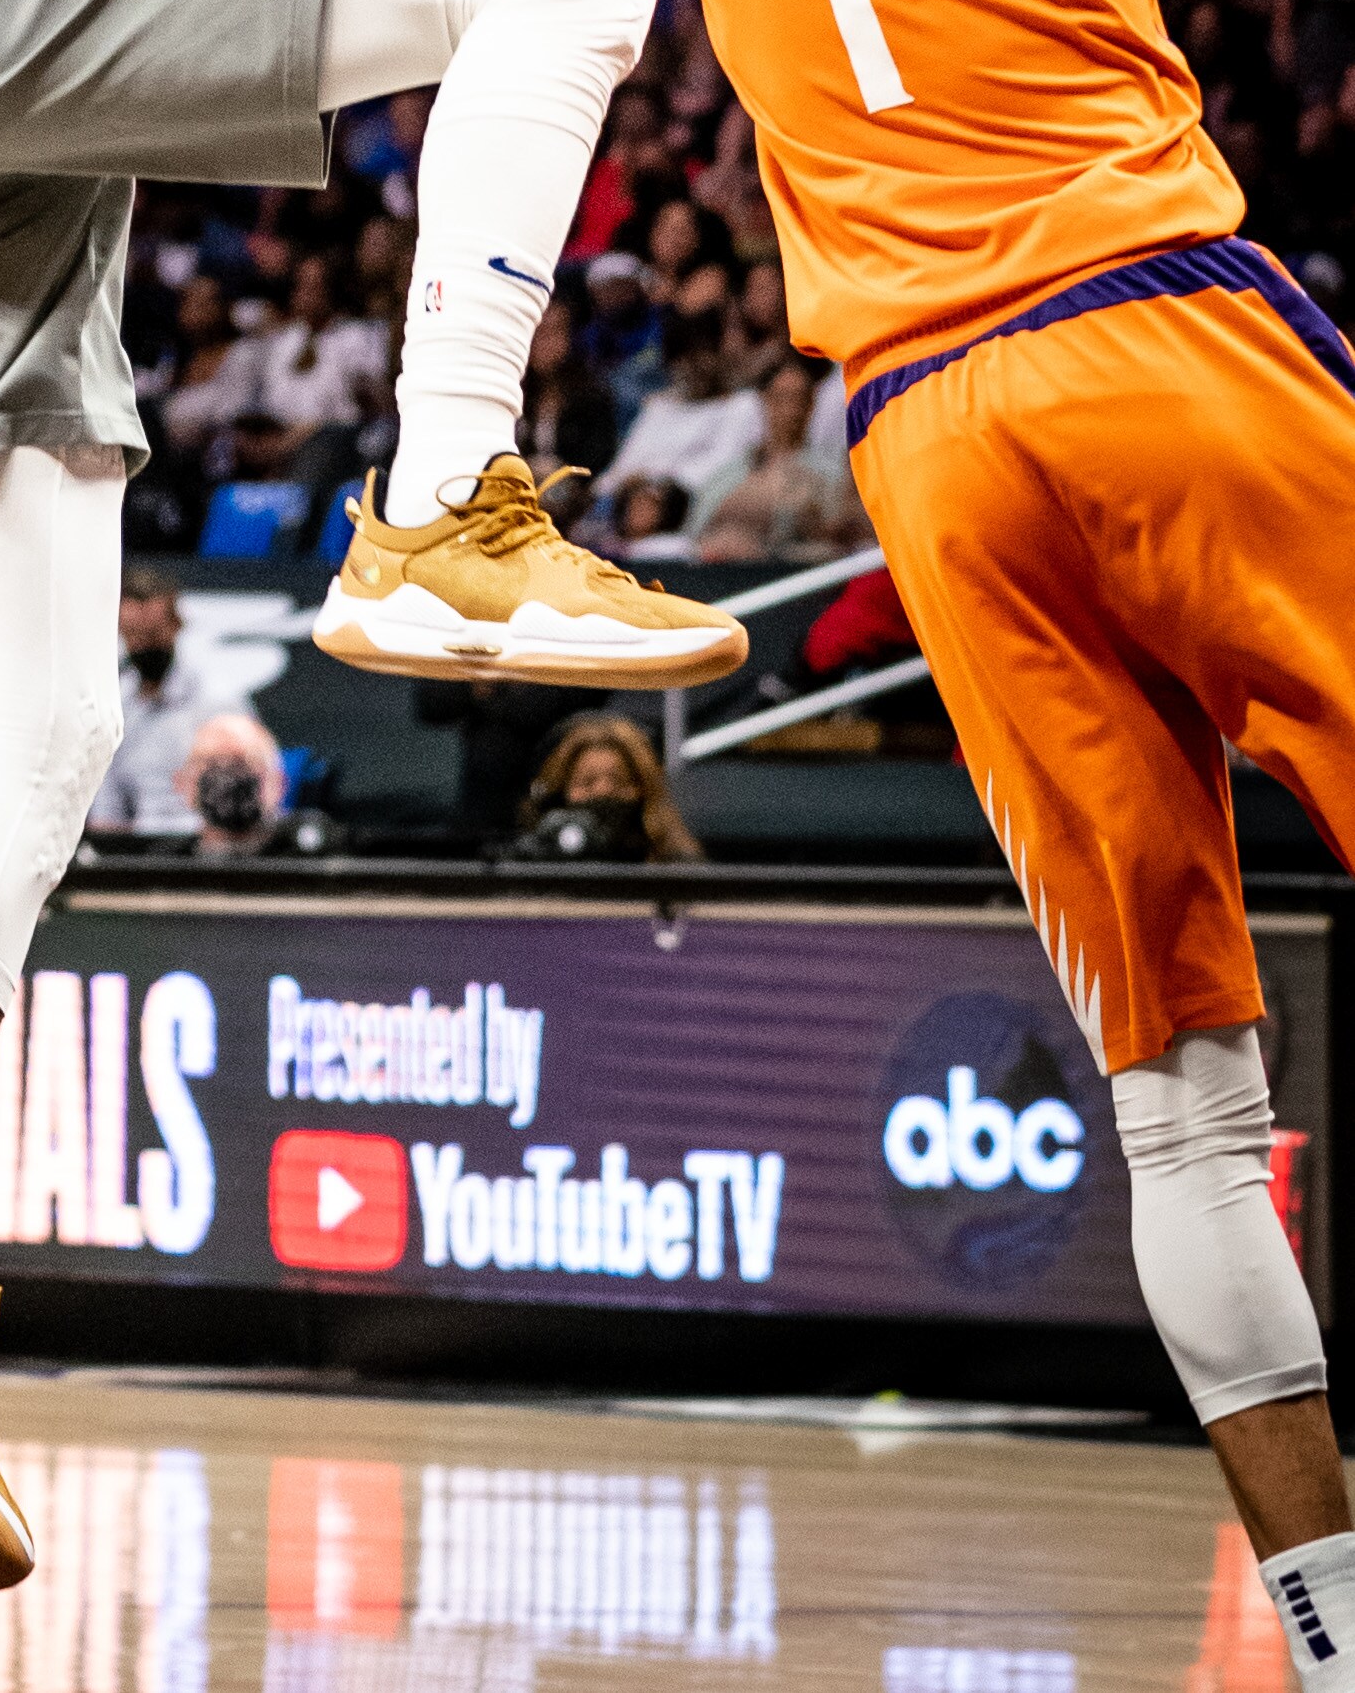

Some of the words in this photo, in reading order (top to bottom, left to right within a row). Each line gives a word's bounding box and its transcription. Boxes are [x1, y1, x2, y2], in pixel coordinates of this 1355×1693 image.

[267, 974, 483, 1106] Presented
[485, 981, 544, 1128] by
[882, 1064, 1087, 1194] abc
